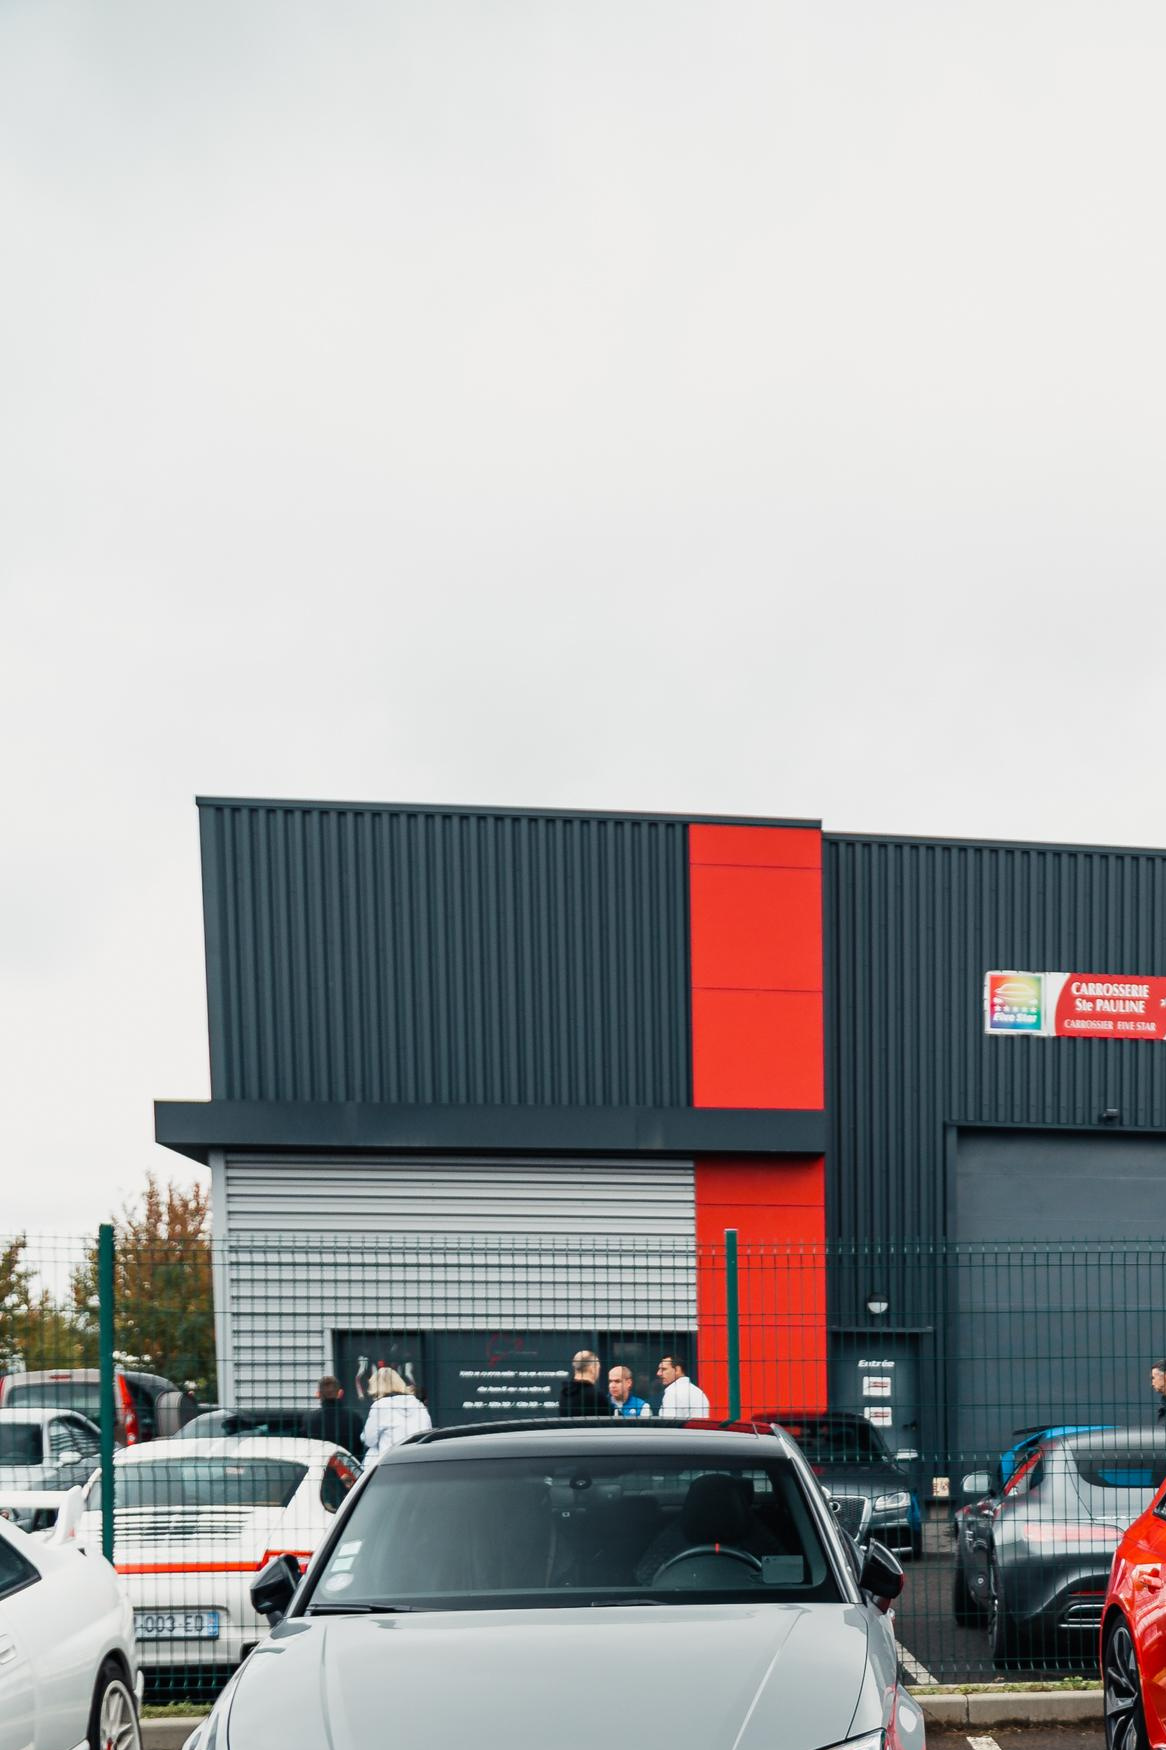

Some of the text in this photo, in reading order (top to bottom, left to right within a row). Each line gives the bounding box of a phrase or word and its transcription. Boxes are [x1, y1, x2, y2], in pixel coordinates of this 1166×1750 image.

[1071, 982, 1150, 997] CARROSSERIE
[1075, 998, 1146, 1013] Ste PAULINE
[1064, 1019, 1114, 1030] CARROSSIER
[1135, 1022, 1157, 1032] STAR
